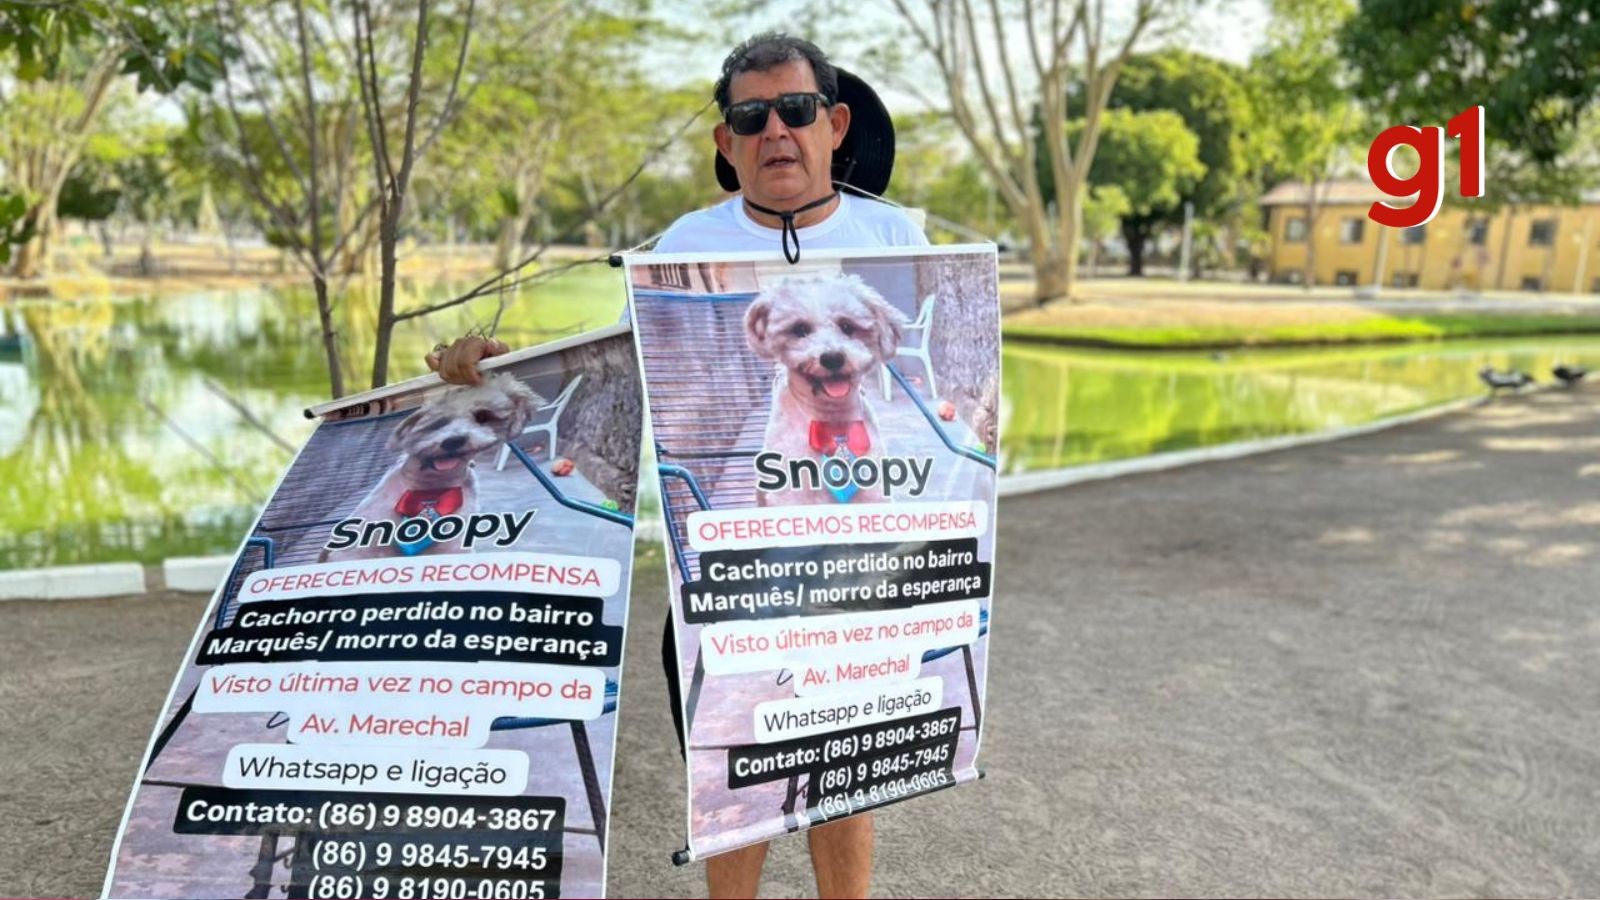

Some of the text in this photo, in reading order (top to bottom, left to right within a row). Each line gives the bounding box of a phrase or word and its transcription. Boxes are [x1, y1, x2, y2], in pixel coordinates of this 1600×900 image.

[754, 452, 934, 496] Snoopy
[325, 508, 538, 550] Snoopy
[700, 511, 976, 541] OFERECEMOS RECOMPENSA
[250, 563, 601, 594] OFERECEMOS RECOMPENSA
[709, 549, 973, 582] Cachorro perdido no bairro
[689, 574, 981, 613] Marquês/ morro da esperança
[240, 601, 594, 628] Cachorro perdido no bairro
[206, 628, 608, 660] Marquês/ morro da esperança
[711, 610, 973, 655] Visto última vez no campo da
[211, 672, 593, 701] Visto última vez no campo da
[803, 655, 910, 687] Av. Marechal
[300, 713, 470, 737] Av. Marechal
[764, 689, 932, 732] Whatsapp e ligação
[735, 717, 958, 777] Contato: (86) 9 8904-3867
[239, 756, 507, 789] Whatsapp e ligação
[820, 744, 949, 795] (86) 9 9845-7945
[817, 768, 947, 821] (86) 9 8190-0605
[186, 800, 556, 831] Contato: (86) 9 8904-3867
[312, 840, 547, 872] (86) 9 9845-7945
[308, 875, 545, 899] (86) 9 8190-0605
